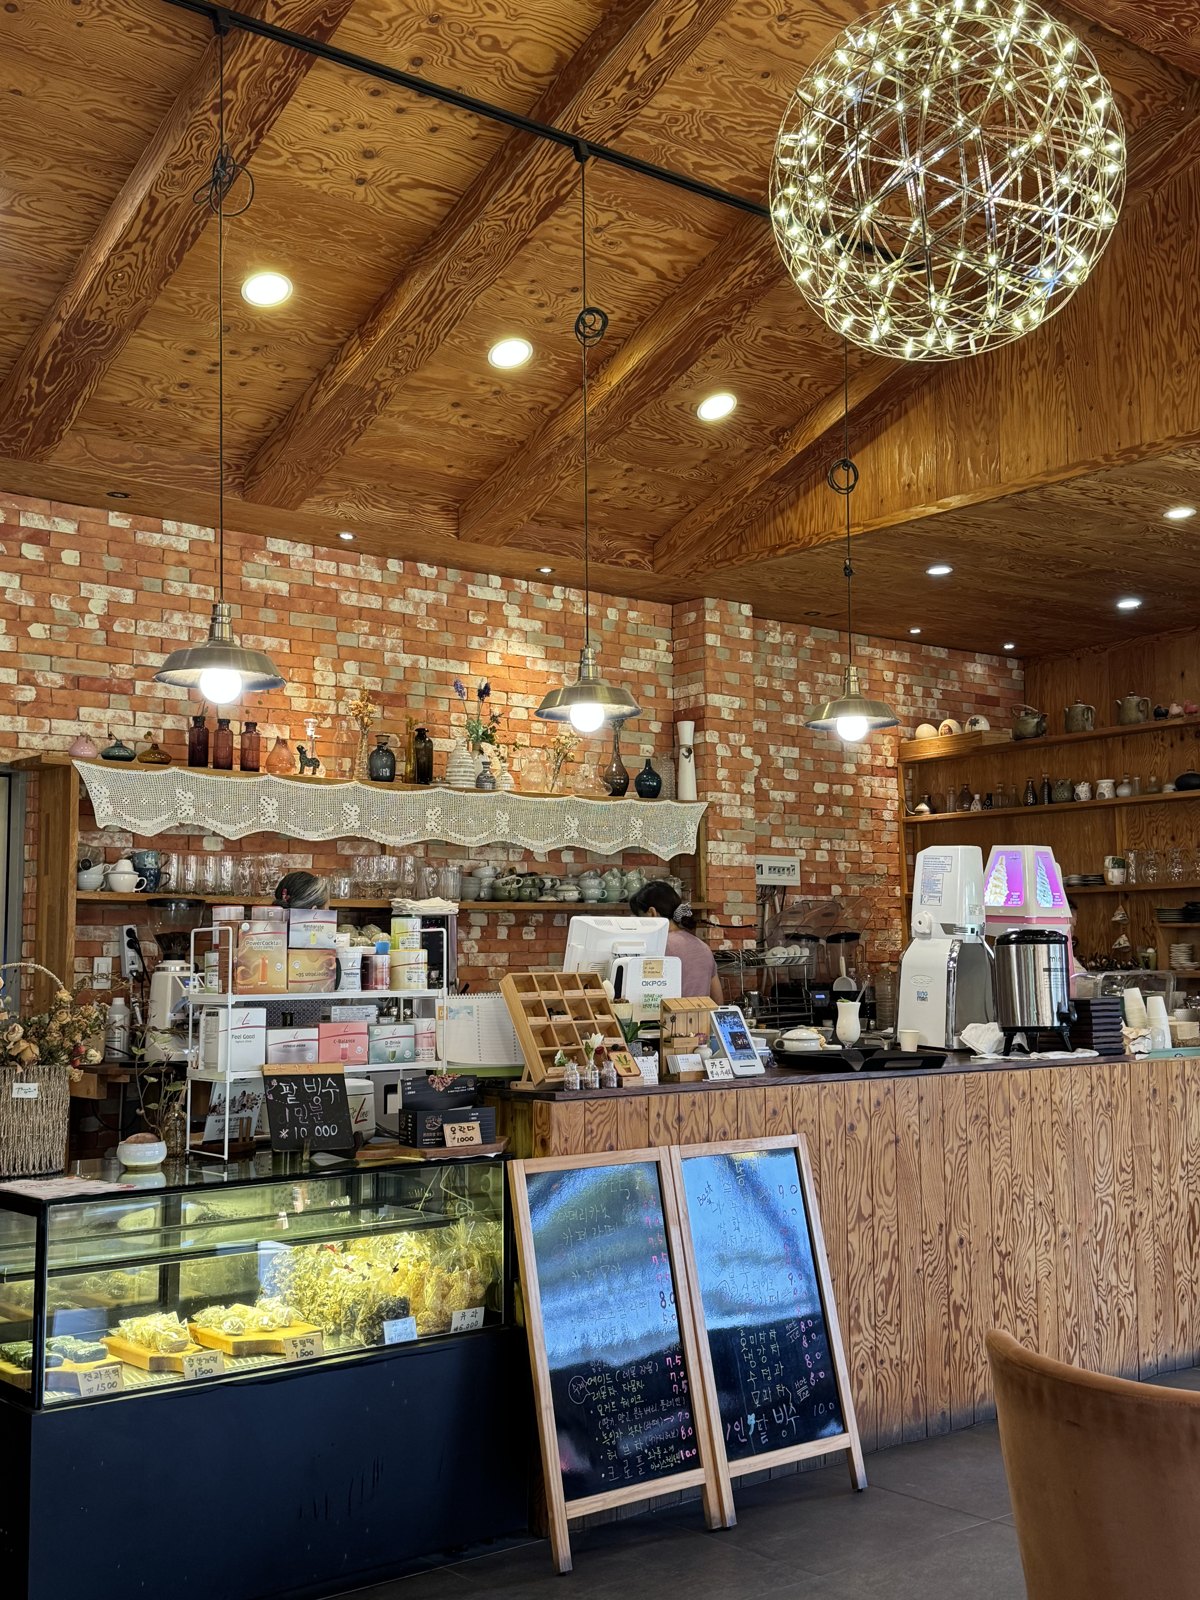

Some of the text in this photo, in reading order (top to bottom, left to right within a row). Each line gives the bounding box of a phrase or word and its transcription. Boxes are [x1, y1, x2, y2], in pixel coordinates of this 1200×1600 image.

[450, 1125, 475, 1134] 오란다
[659, 1290, 675, 1310] 8.0
[460, 1310, 478, 1319] 유과
[800, 1319, 813, 1333] 8.0
[802, 1332, 817, 1348] 8.0
[666, 1355, 682, 1368] 7.5
[804, 1351, 822, 1369] 8.0
[670, 1371, 684, 1382] 7.0
[672, 1380, 688, 1395] 7.5
[813, 1402, 835, 1417] 10.0
[681, 1425, 693, 1440] 8.0
